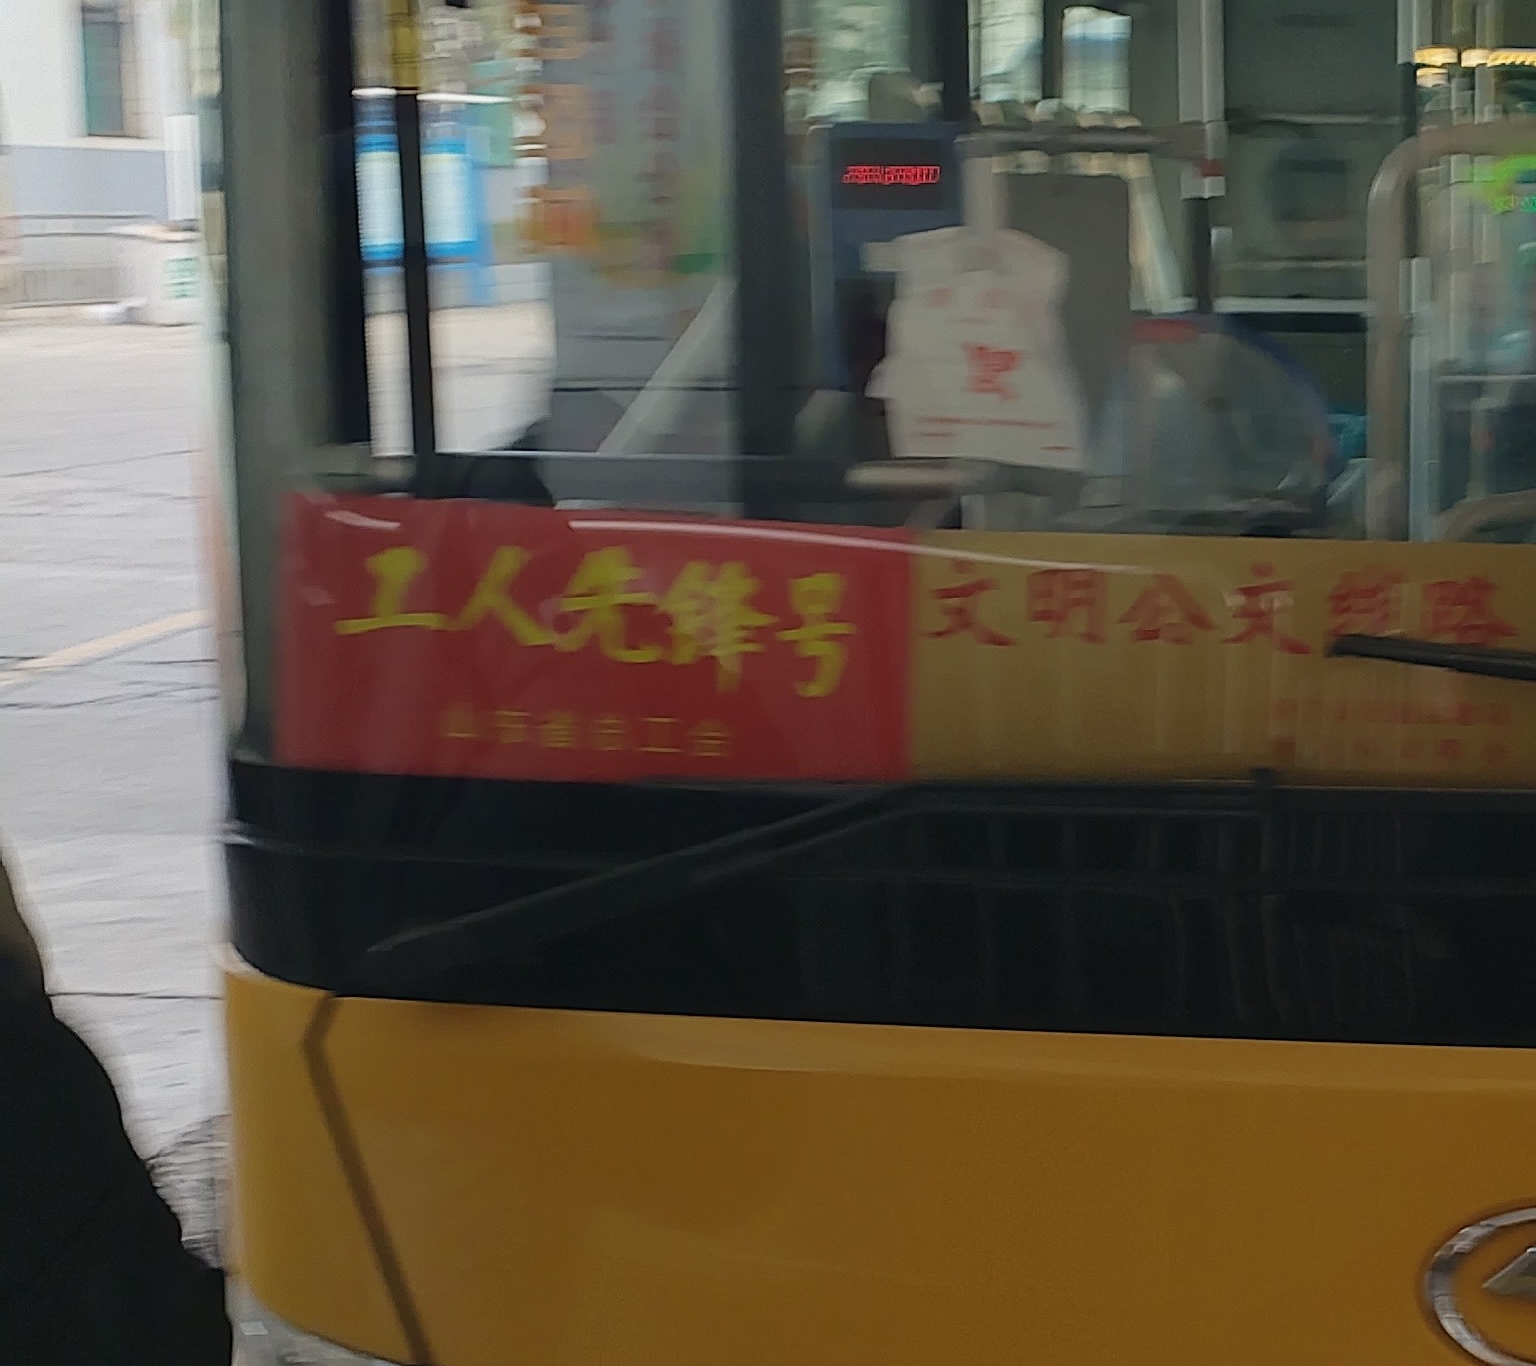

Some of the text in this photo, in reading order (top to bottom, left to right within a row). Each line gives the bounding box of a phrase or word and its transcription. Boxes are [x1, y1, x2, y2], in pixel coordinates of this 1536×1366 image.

[335, 544, 858, 697] 工人先锋号
